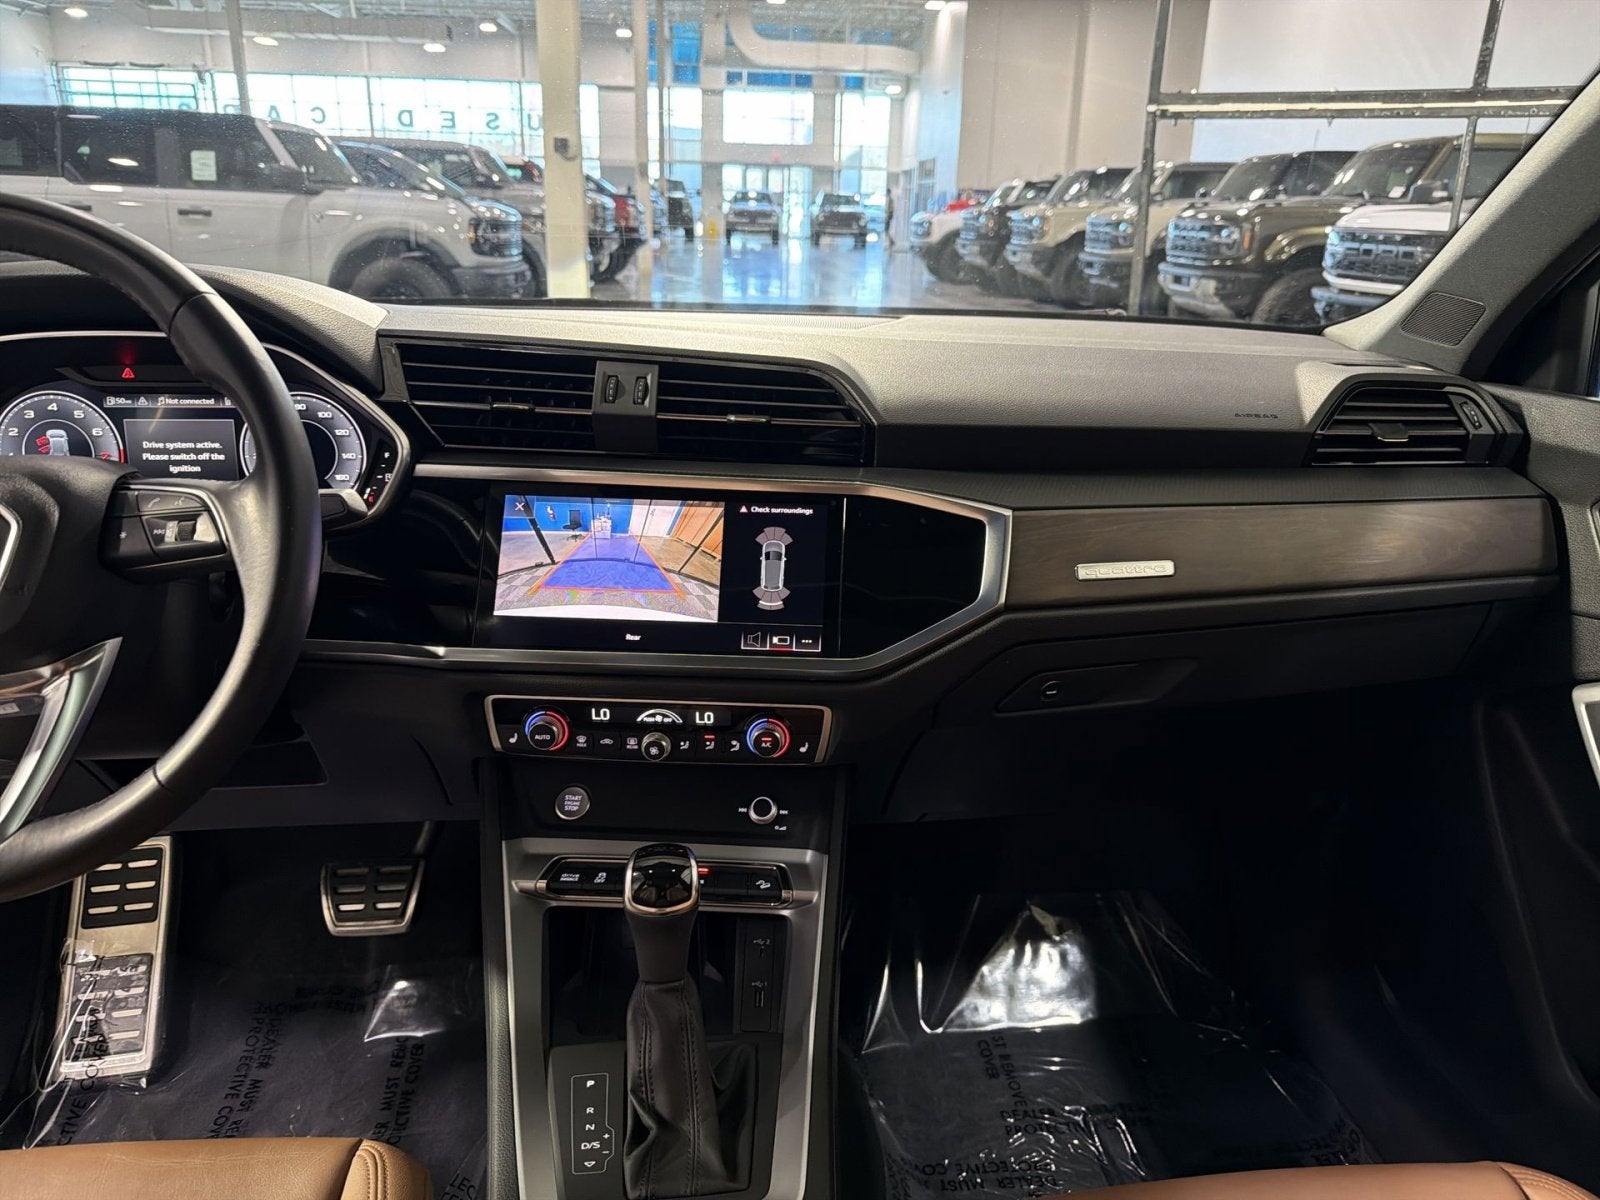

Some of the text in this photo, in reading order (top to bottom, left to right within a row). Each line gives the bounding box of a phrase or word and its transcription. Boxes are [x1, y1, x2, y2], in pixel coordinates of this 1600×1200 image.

[180, 397, 214, 405] connected
[47, 402, 58, 411] 4
[23, 410, 35, 418] 3
[73, 410, 85, 418] 5
[8, 428, 19, 436] 2
[92, 428, 103, 436] 6
[165, 442, 195, 450] system
[195, 441, 222, 449] active.
[169, 464, 201, 473] ignition
[771, 507, 813, 515] surroundings
[1085, 565, 1167, 578] quattro
[625, 633, 641, 641] Rear
[591, 708, 610, 720] LO
[695, 712, 714, 724] LO
[256, 1018, 283, 1069] DEALER
[225, 1017, 264, 1100] PROTECTIVE
[977, 1039, 1000, 1079] COVER
[405, 1043, 425, 1084] COVER
[586, 1080, 595, 1088] P
[998, 1054, 1028, 1107] REMOVE
[237, 1078, 263, 1113] MUST
[380, 1076, 400, 1111] MUST
[585, 1123, 595, 1131] N
[581, 1141, 600, 1150] D/S
[940, 1175, 1057, 1191] DEALER MUST
